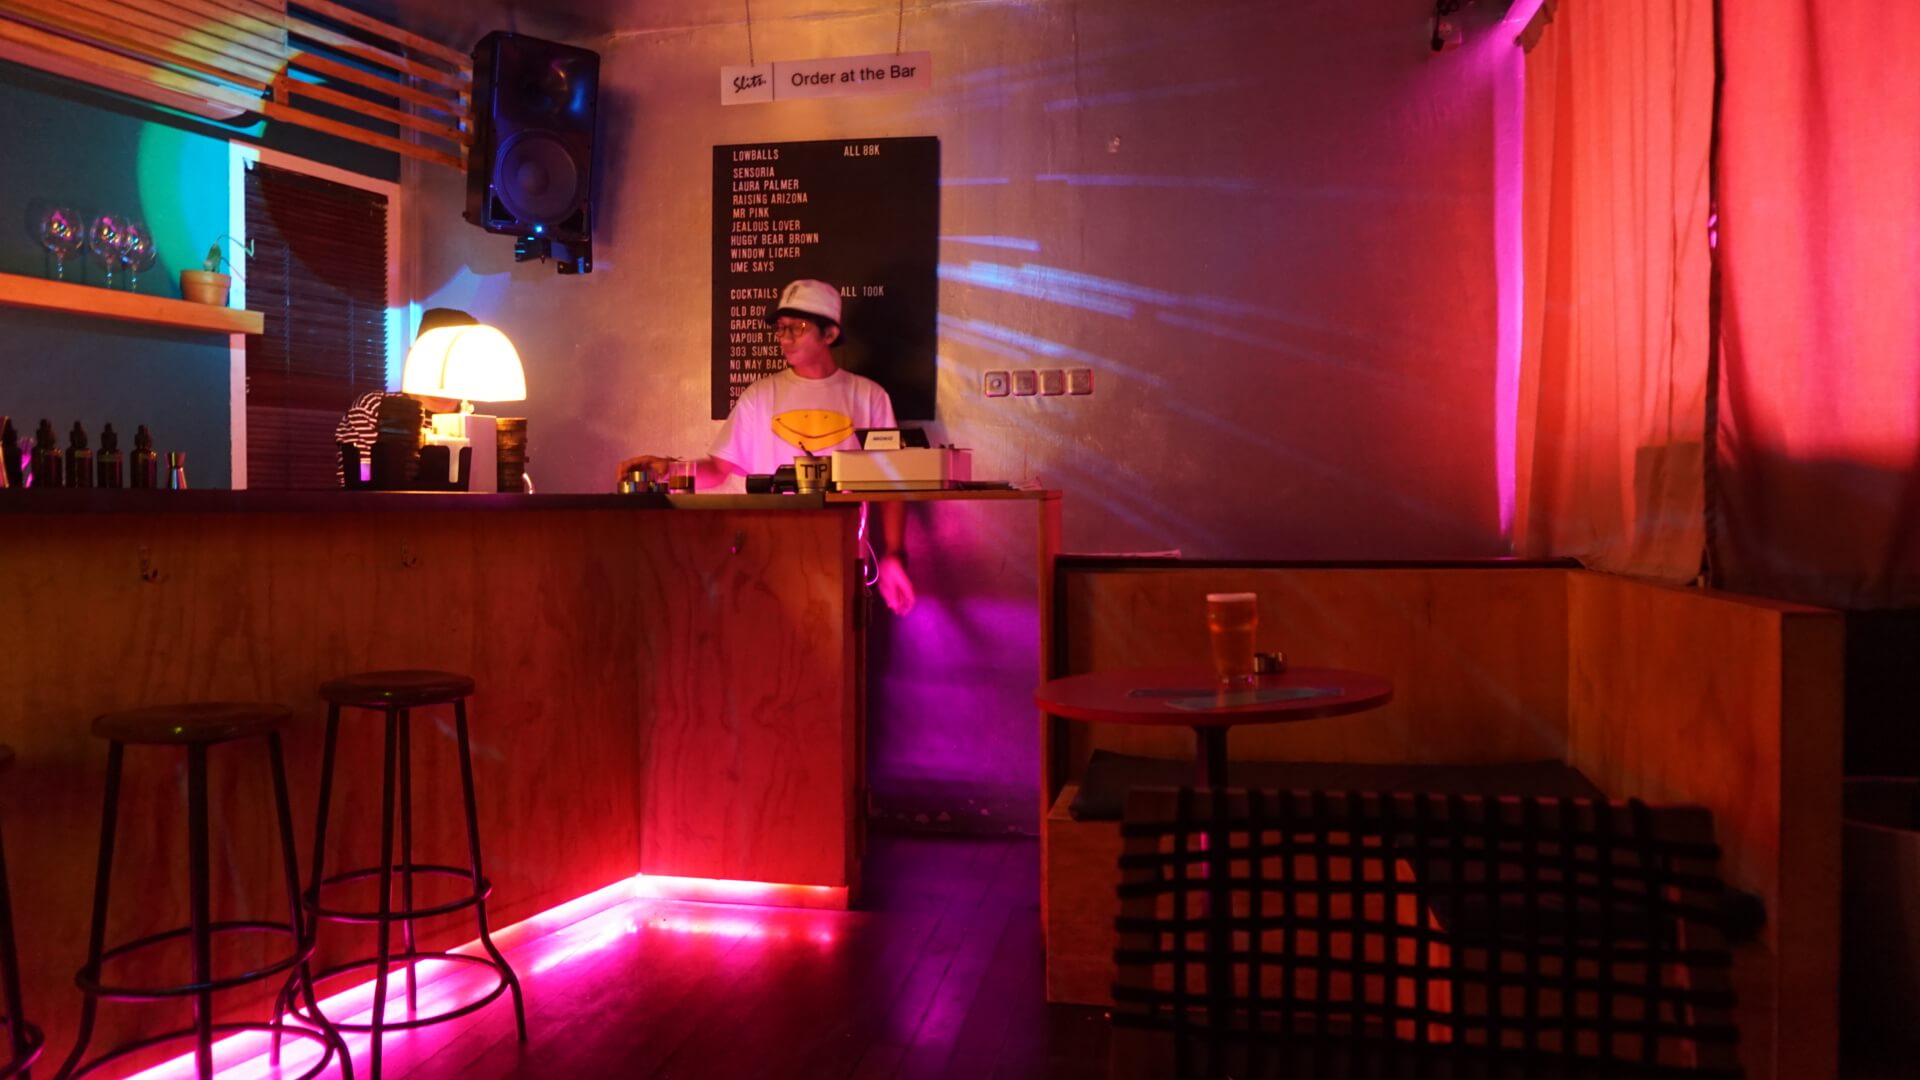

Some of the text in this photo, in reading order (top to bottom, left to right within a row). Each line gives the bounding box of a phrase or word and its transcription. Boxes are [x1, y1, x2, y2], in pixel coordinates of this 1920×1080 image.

[791, 72, 836, 87] Order
[841, 69, 855, 83] at
[860, 67, 885, 81] the
[890, 64, 916, 79] Bar
[733, 144, 880, 161] LOWBALLS ALL 88K
[733, 167, 775, 179] SENSORIA
[733, 179, 800, 192] LAURA PALMER
[733, 192, 808, 205] RAISING ARIZONA
[732, 207, 769, 218] MR PINK
[732, 219, 801, 232] JEALOUS LOVER
[731, 232, 819, 246] HUGGY BEAR BROWN
[731, 246, 800, 259] WINDOW LICKER
[731, 261, 775, 273] UME SAYS
[730, 285, 884, 300] COCKTAILS ALL 100K
[730, 305, 767, 317] OLD BOY
[730, 332, 763, 343] VAPOUR
[730, 346, 746, 357] 303
[730, 359, 788, 370] NO WAY BACK
[800, 463, 828, 479] TIP
